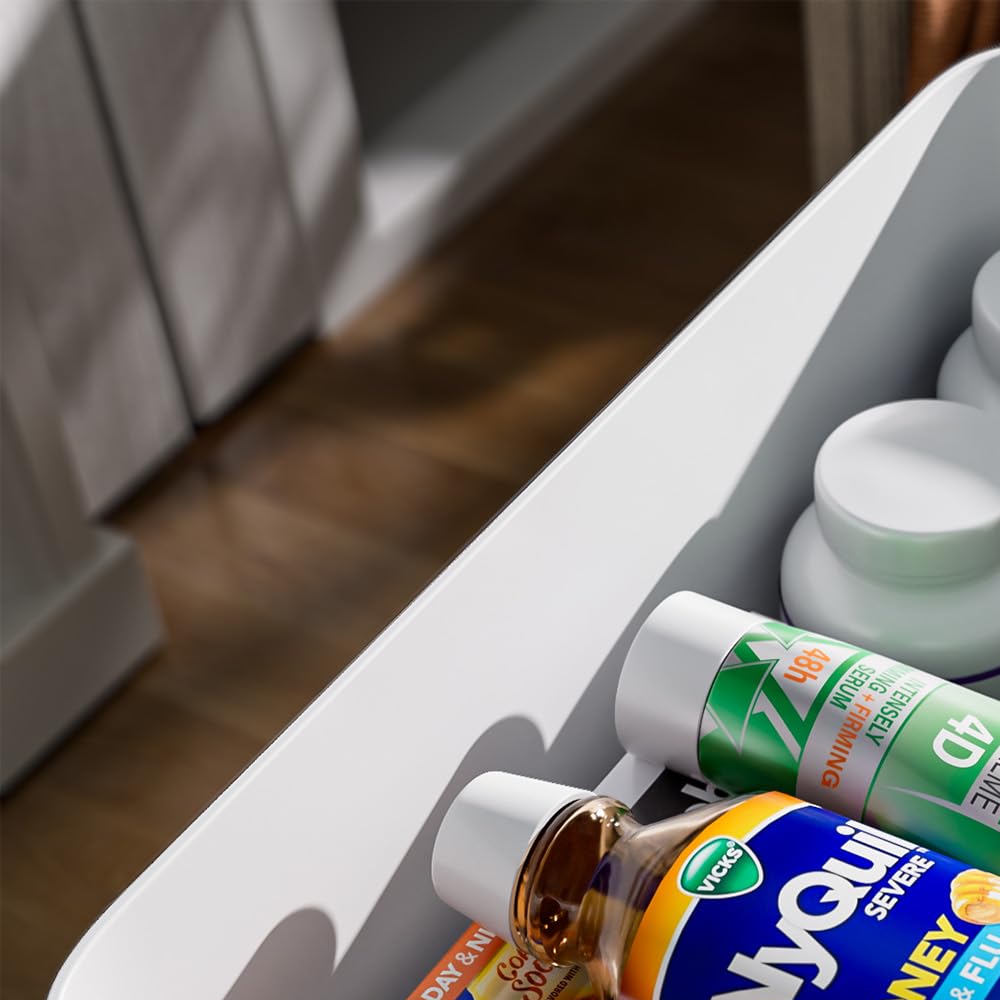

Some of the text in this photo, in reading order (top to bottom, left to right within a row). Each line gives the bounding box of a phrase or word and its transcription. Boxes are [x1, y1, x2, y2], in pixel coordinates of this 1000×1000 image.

[784, 648, 831, 684] 48h
[830, 664, 876, 710] SERUM
[821, 703, 871, 790] FIRMING
[932, 714, 994, 768] 4D
[864, 852, 935, 921] SEVERE
[455, 952, 479, 966] &
